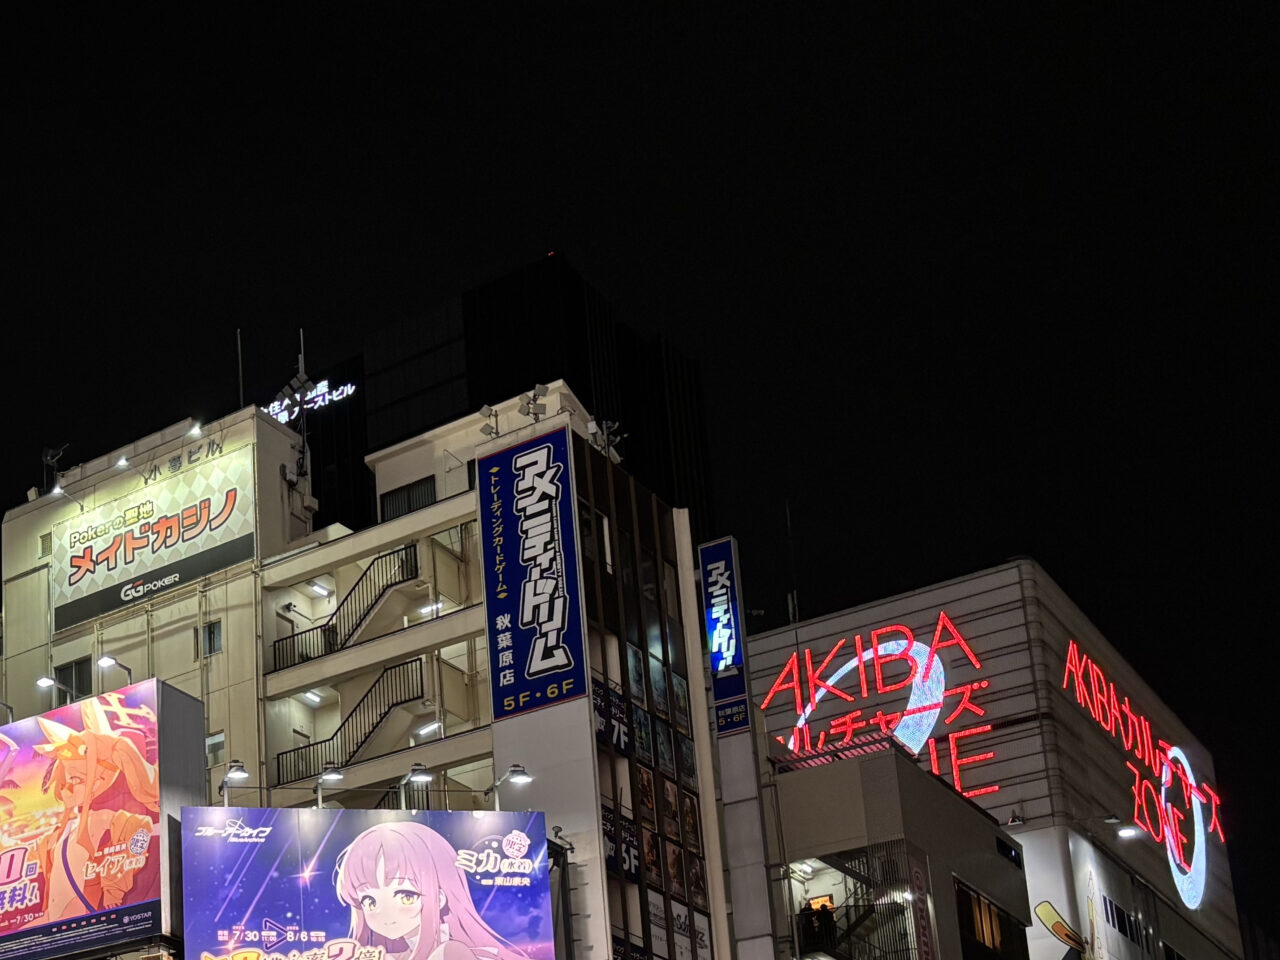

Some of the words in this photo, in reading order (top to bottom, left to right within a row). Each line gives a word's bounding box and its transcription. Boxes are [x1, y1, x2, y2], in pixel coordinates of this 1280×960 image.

[68, 487, 237, 586] メイドカジノ
[70, 501, 154, 548] Pokerの聖地
[489, 475, 508, 592] トレーディングカードゲーム
[120, 573, 180, 601] GGPOKER
[495, 613, 516, 687] 秋葉原店
[760, 610, 982, 715] AKIBA
[195, 825, 272, 838] ブルーアーカイブ
[129, 911, 153, 922] YOSTAR
[232, 930, 259, 942] 7/30
[286, 930, 308, 942] 8/6
